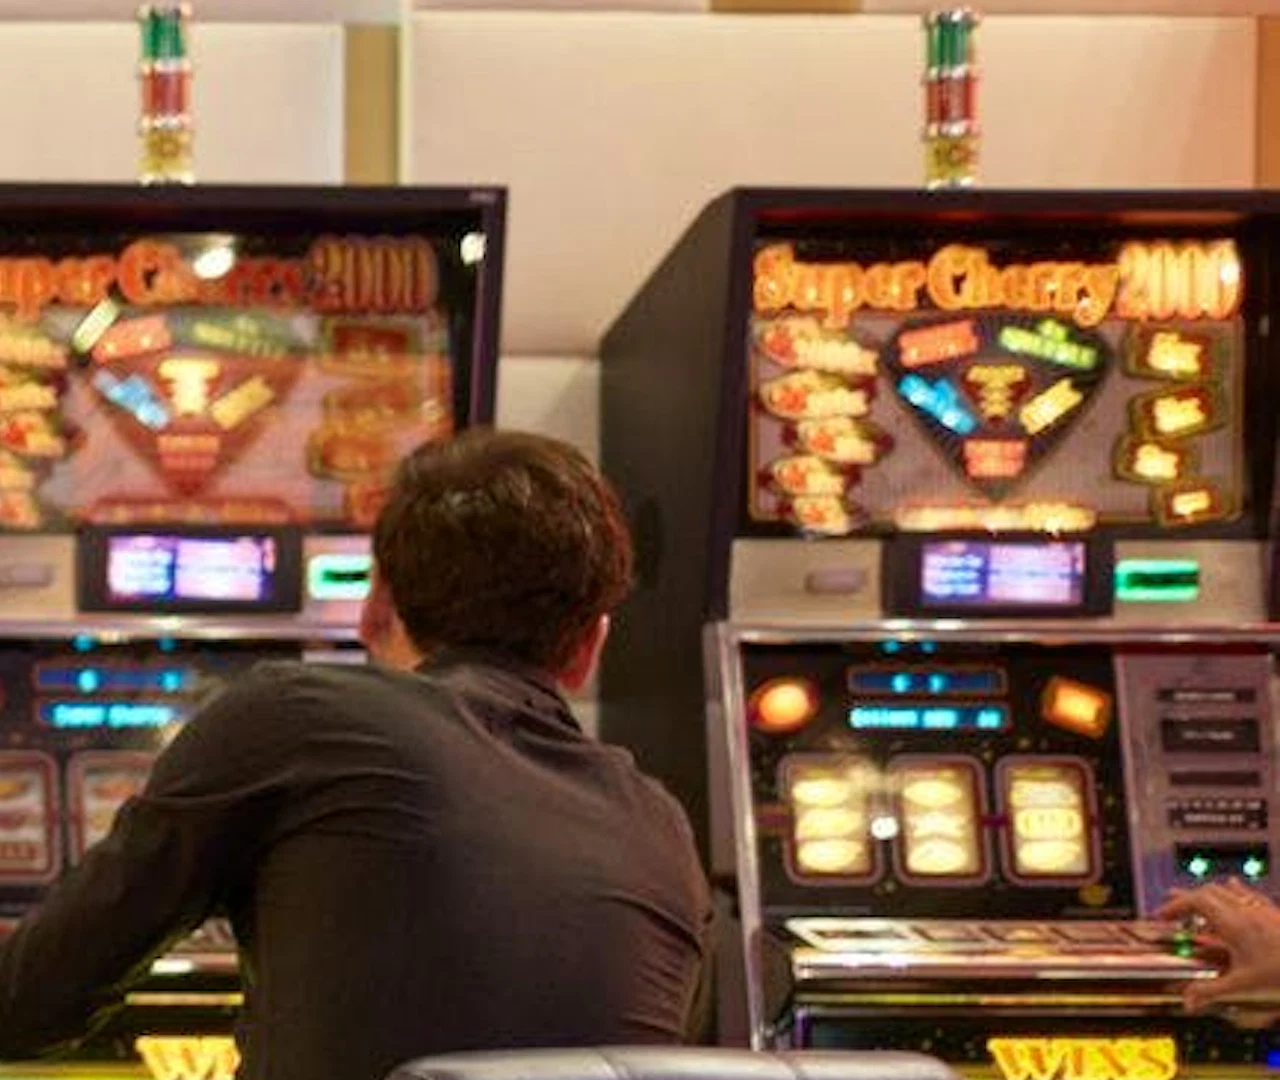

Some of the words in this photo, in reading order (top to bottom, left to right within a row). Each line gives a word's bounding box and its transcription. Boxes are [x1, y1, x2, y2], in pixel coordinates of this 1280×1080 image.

[308, 234, 437, 312] 2000
[754, 243, 927, 328] Super
[928, 244, 1120, 327] Cherry
[1118, 240, 1239, 319] 2000
